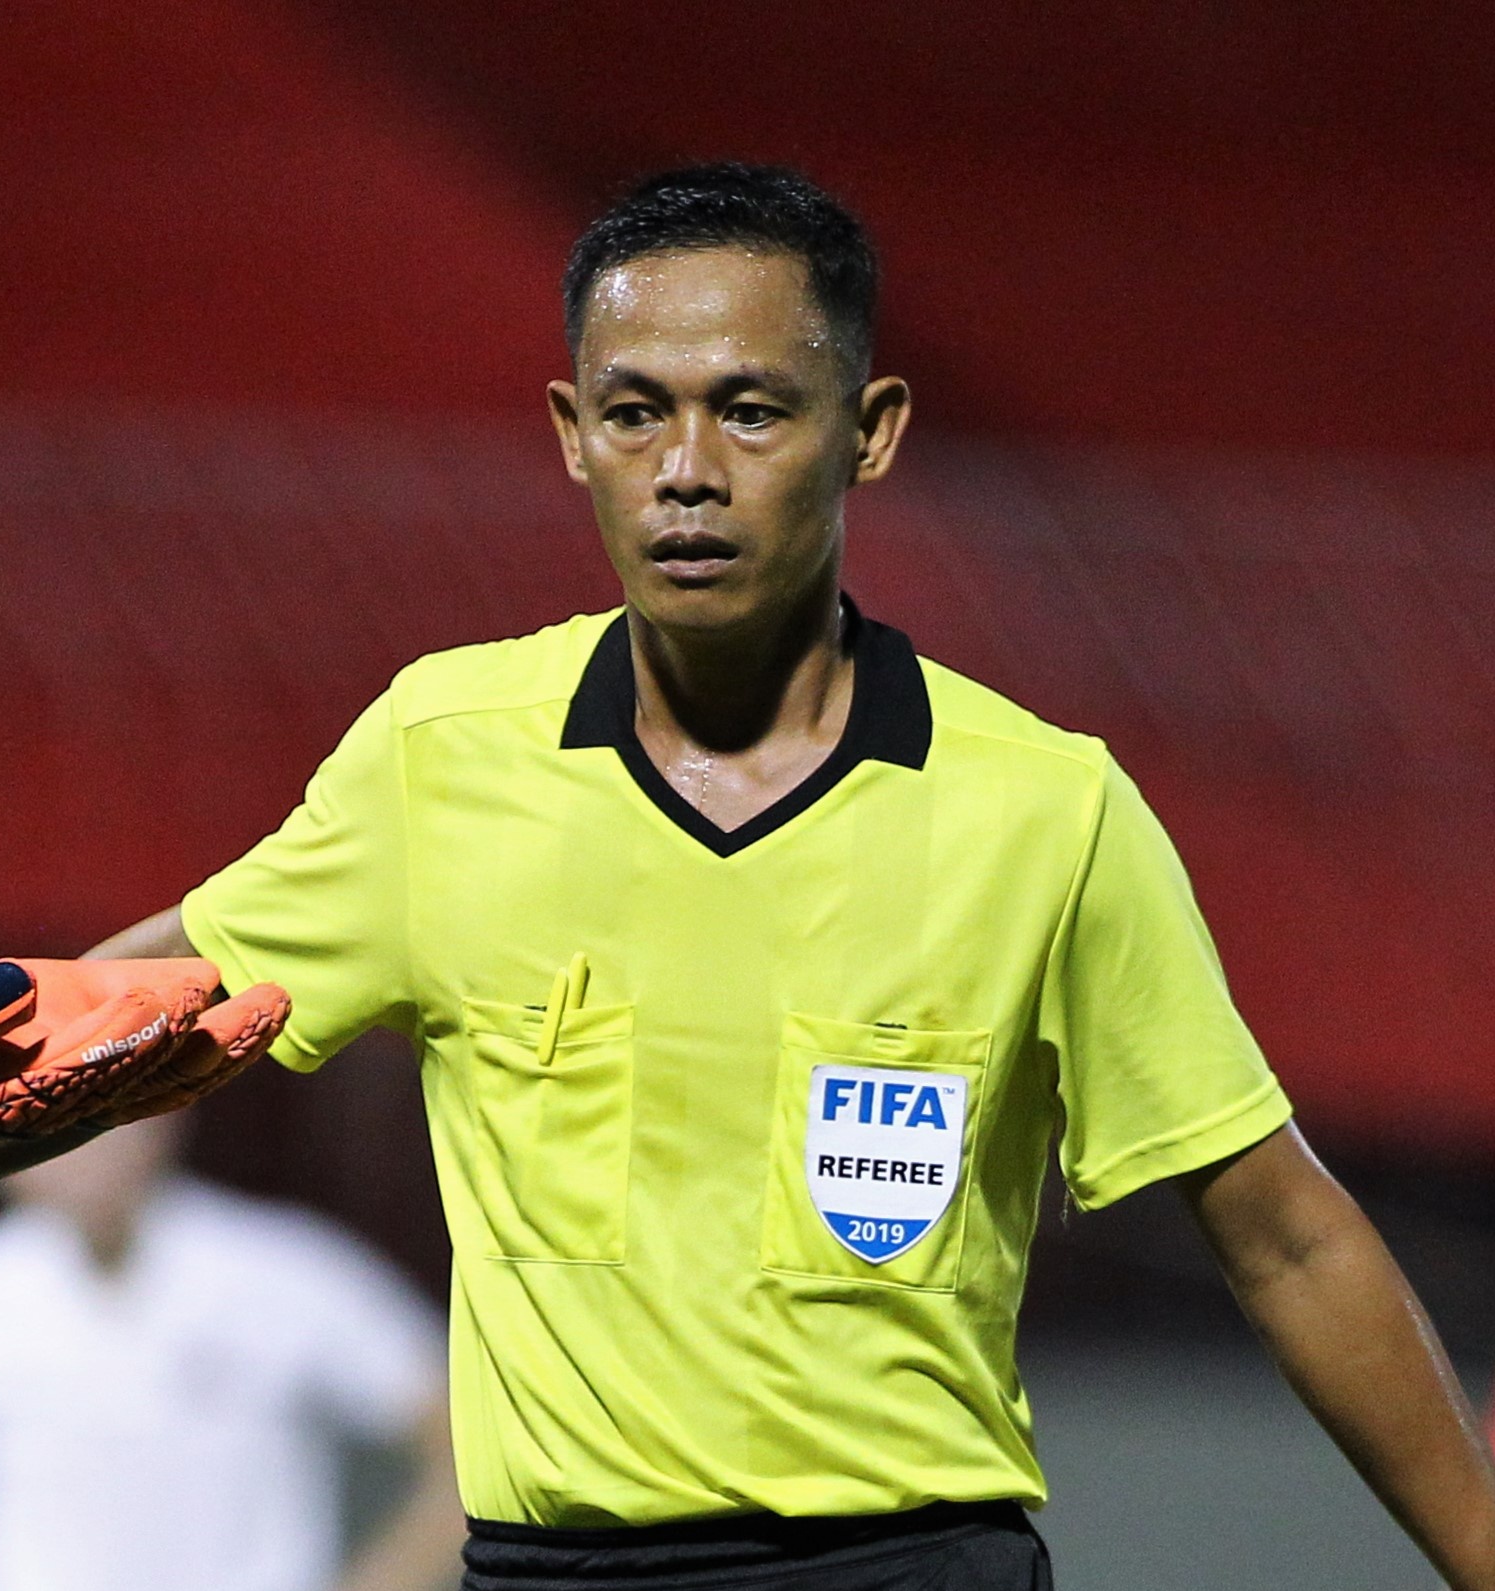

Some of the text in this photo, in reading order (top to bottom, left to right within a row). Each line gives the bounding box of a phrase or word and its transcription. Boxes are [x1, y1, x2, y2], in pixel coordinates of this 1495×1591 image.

[822, 1078, 947, 1130] FIFA
[818, 1154, 944, 1186] REFEREE
[847, 1220, 904, 1244] 2019
